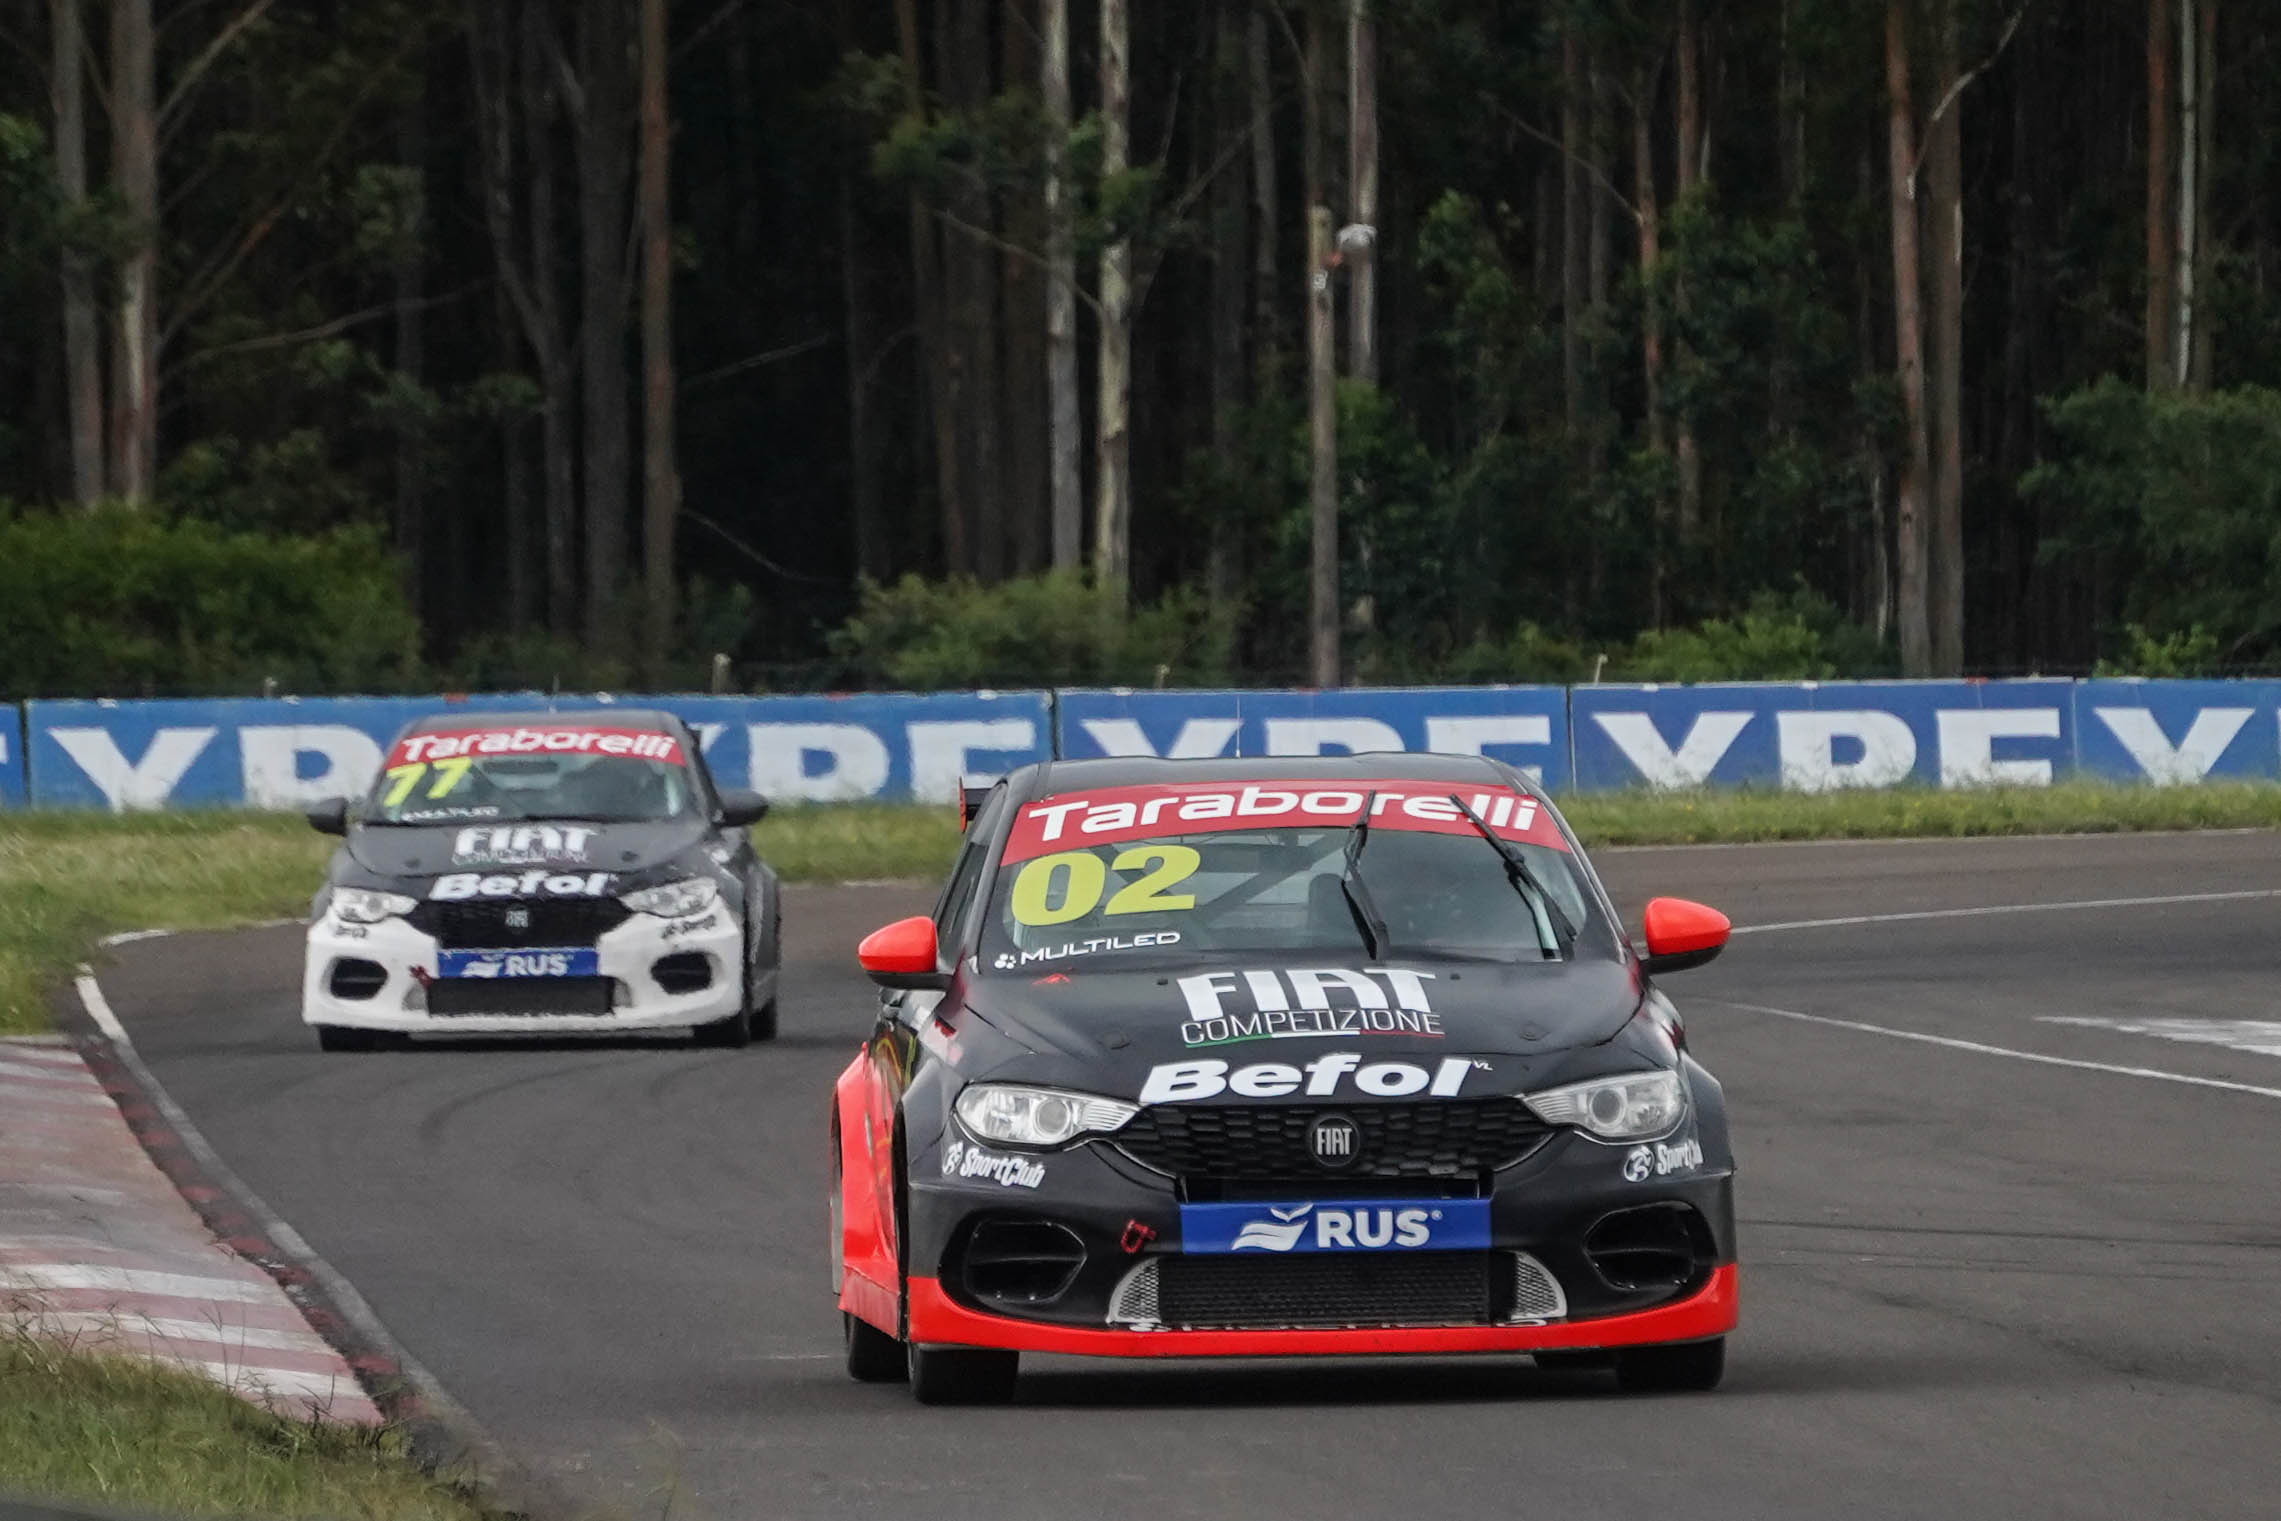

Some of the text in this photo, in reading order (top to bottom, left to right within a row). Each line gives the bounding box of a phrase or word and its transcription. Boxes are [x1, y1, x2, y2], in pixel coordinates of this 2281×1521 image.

[400, 728, 677, 761] Taraborelli
[383, 756, 473, 807] 77
[1028, 787, 1537, 841] Taraborelli
[455, 826, 598, 855] FIAT
[429, 871, 608, 899] Befol
[1011, 845, 1201, 927] 02
[1020, 932, 1181, 964] MULTILED
[1176, 968, 1436, 1021] FIAT
[1180, 1010, 1442, 1044] COMPETIZIONE
[1138, 1054, 1471, 1104] Befol
[1316, 1127, 1352, 1156] FIAT
[959, 1147, 1046, 1188] SportClub
